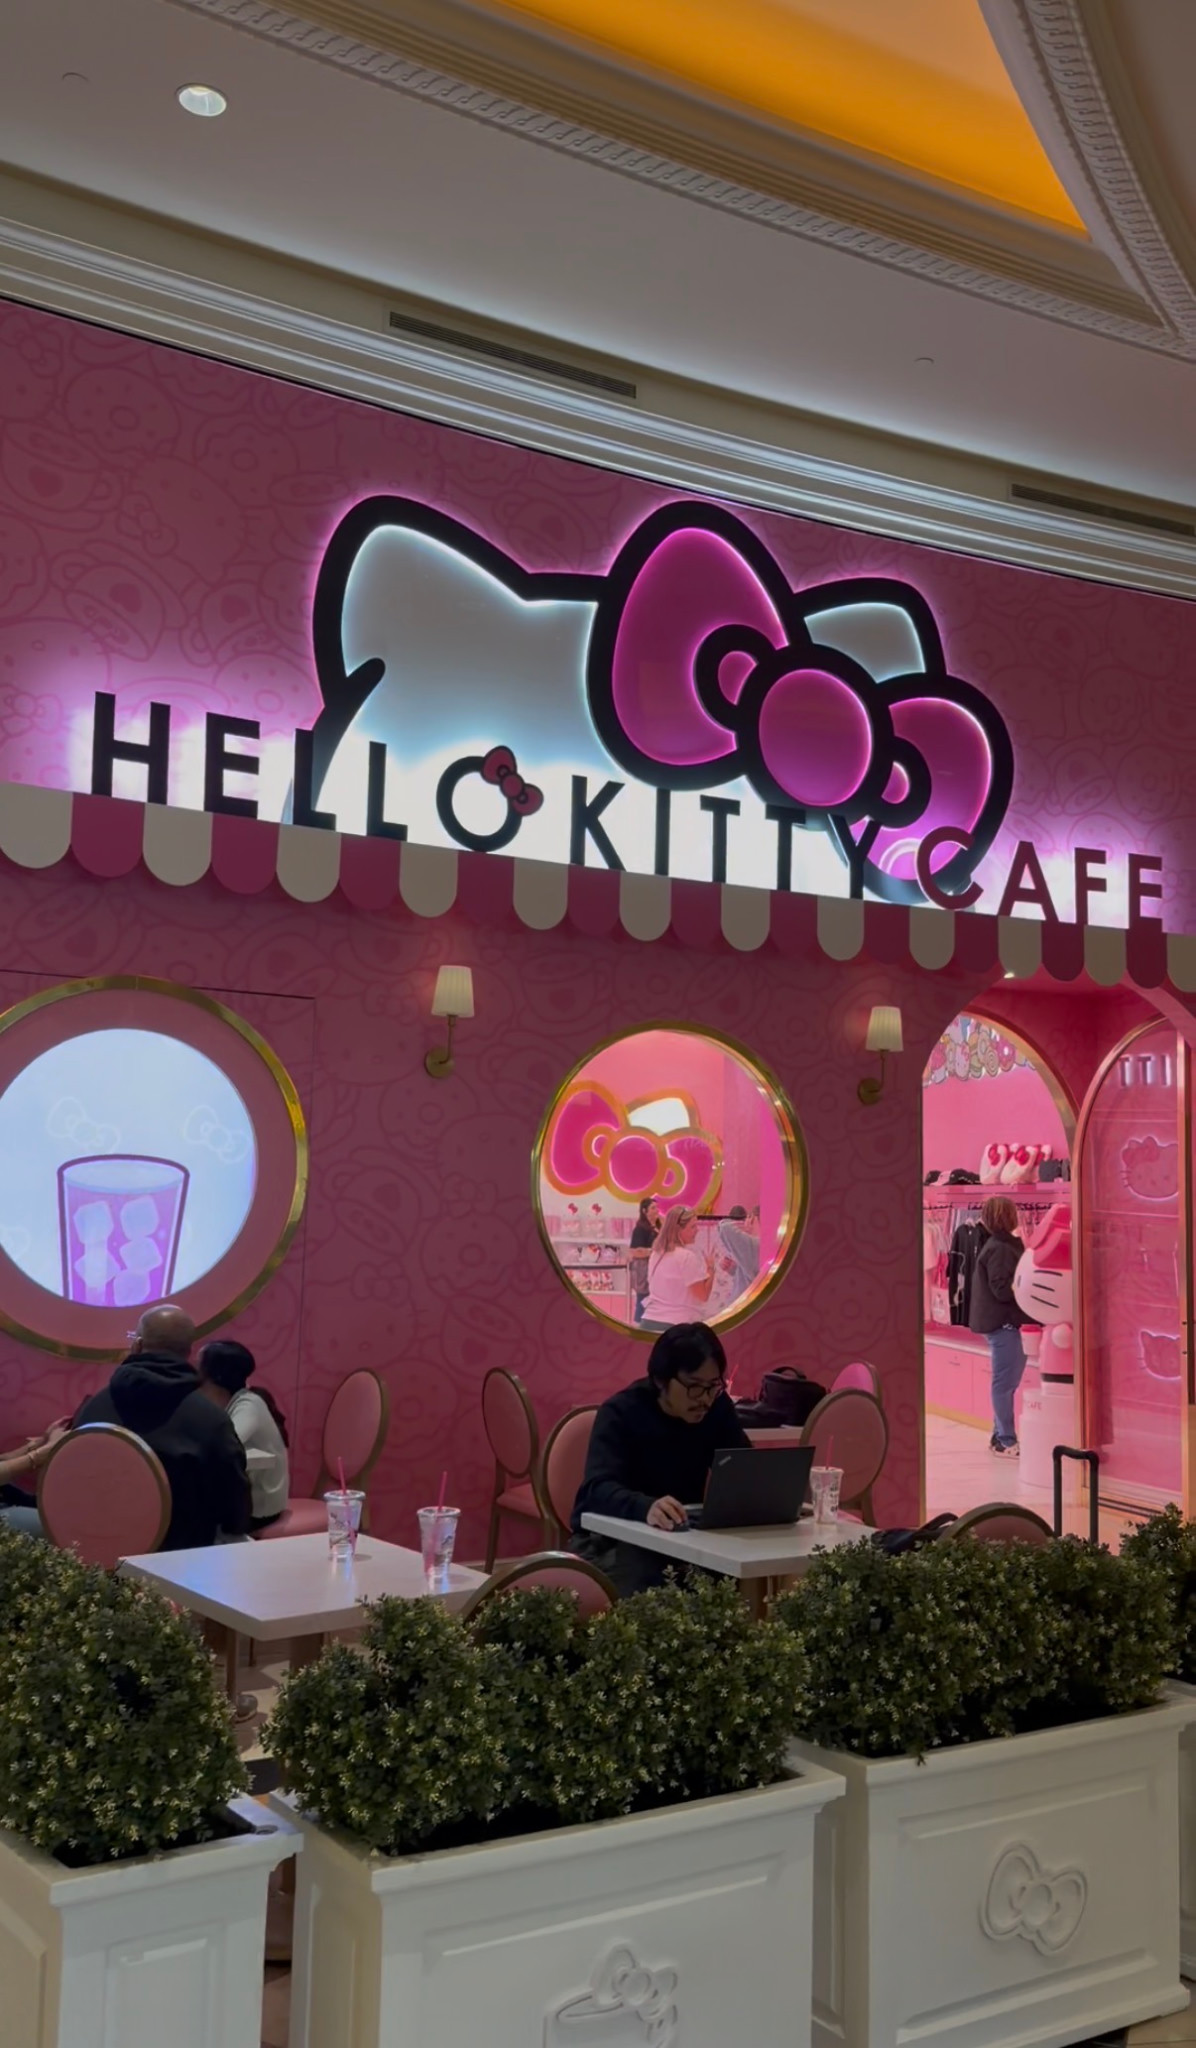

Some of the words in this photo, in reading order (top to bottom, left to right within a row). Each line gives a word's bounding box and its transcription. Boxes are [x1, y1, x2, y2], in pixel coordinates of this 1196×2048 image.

[91, 691, 525, 853] HELLO
[570, 775, 882, 900] KITTY
[916, 826, 1164, 932] CAFE
